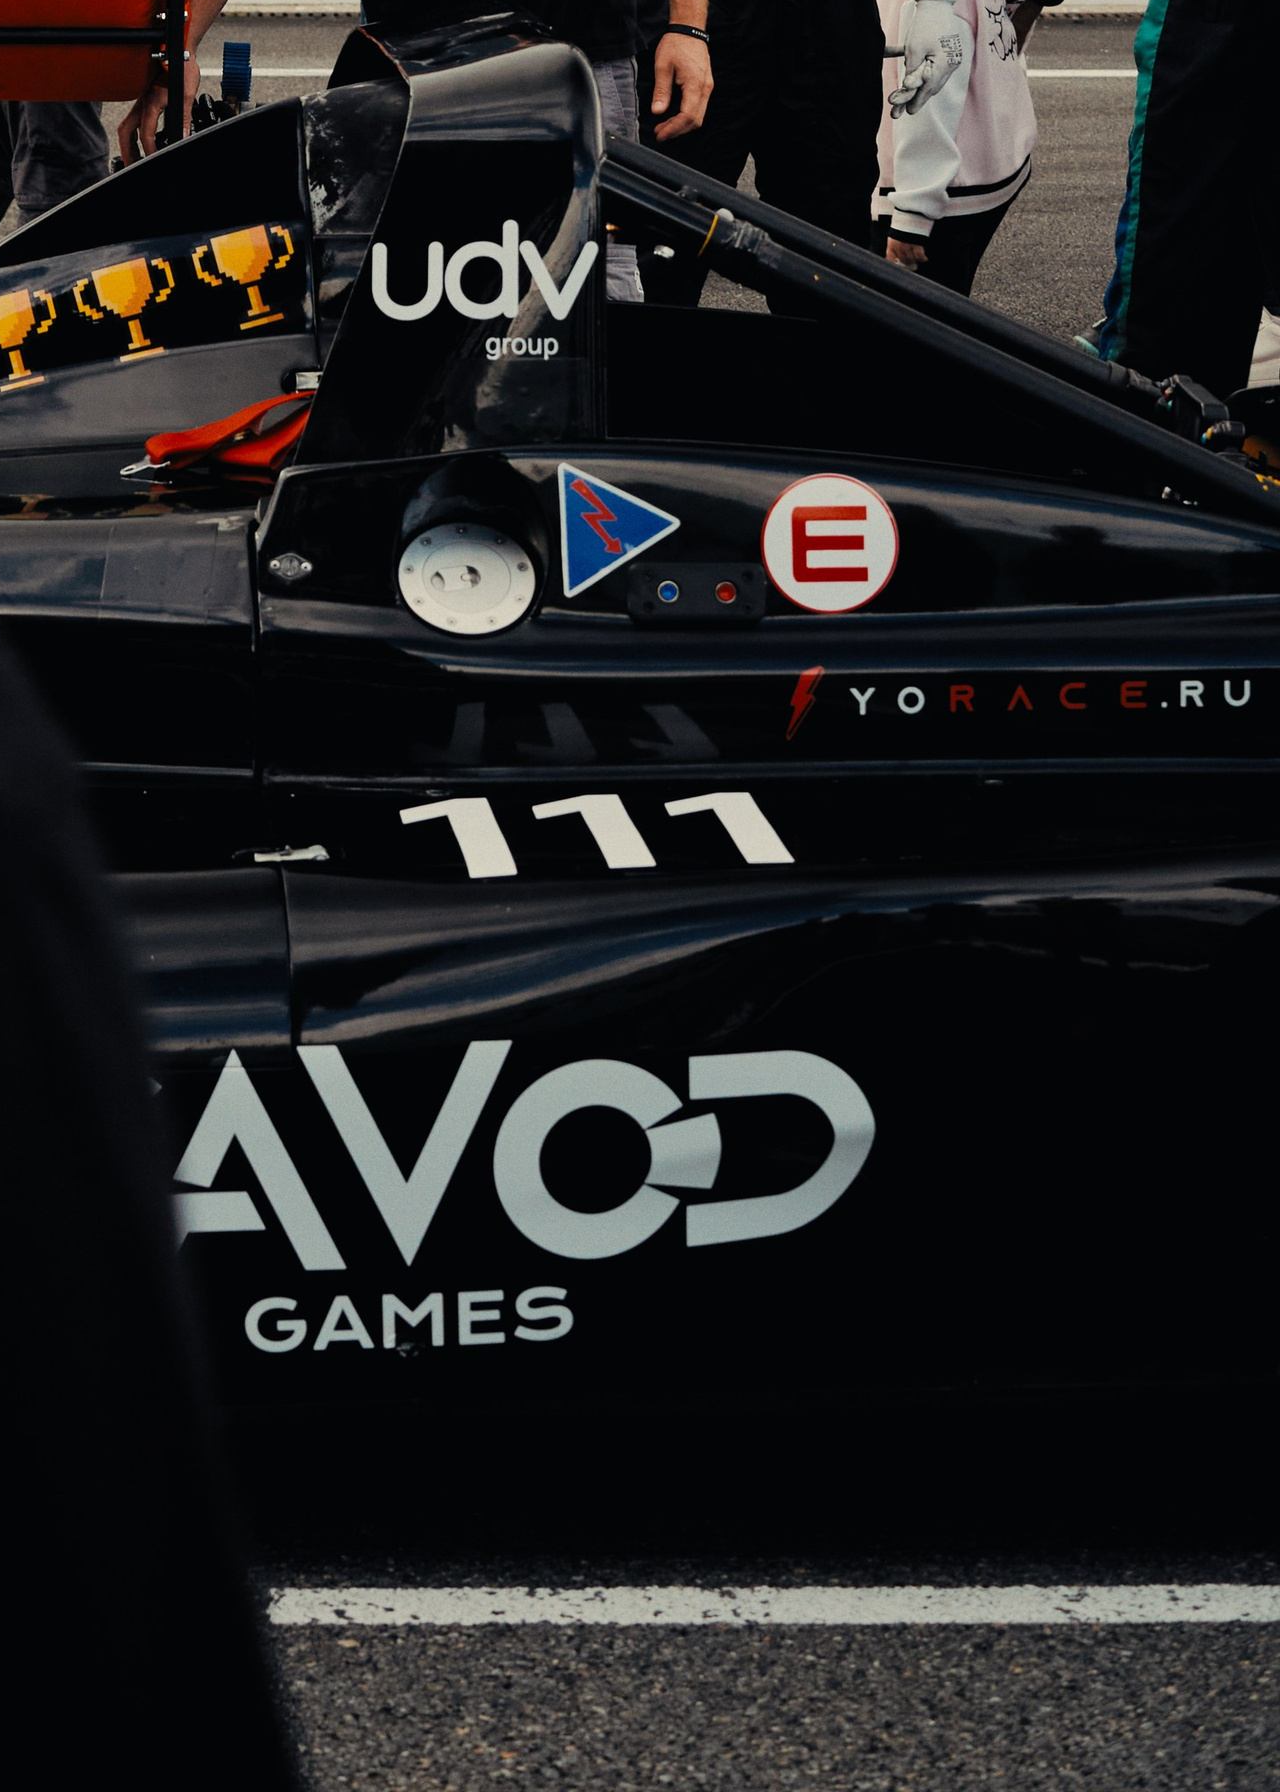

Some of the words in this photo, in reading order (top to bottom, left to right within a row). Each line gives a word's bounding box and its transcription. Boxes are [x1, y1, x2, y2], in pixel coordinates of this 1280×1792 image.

[371, 219, 599, 321] udv
[485, 336, 559, 360] group
[791, 505, 868, 583] E
[399, 792, 796, 879] 111
[152, 1039, 876, 1271] AVOD
[244, 1286, 575, 1354] GAMES
